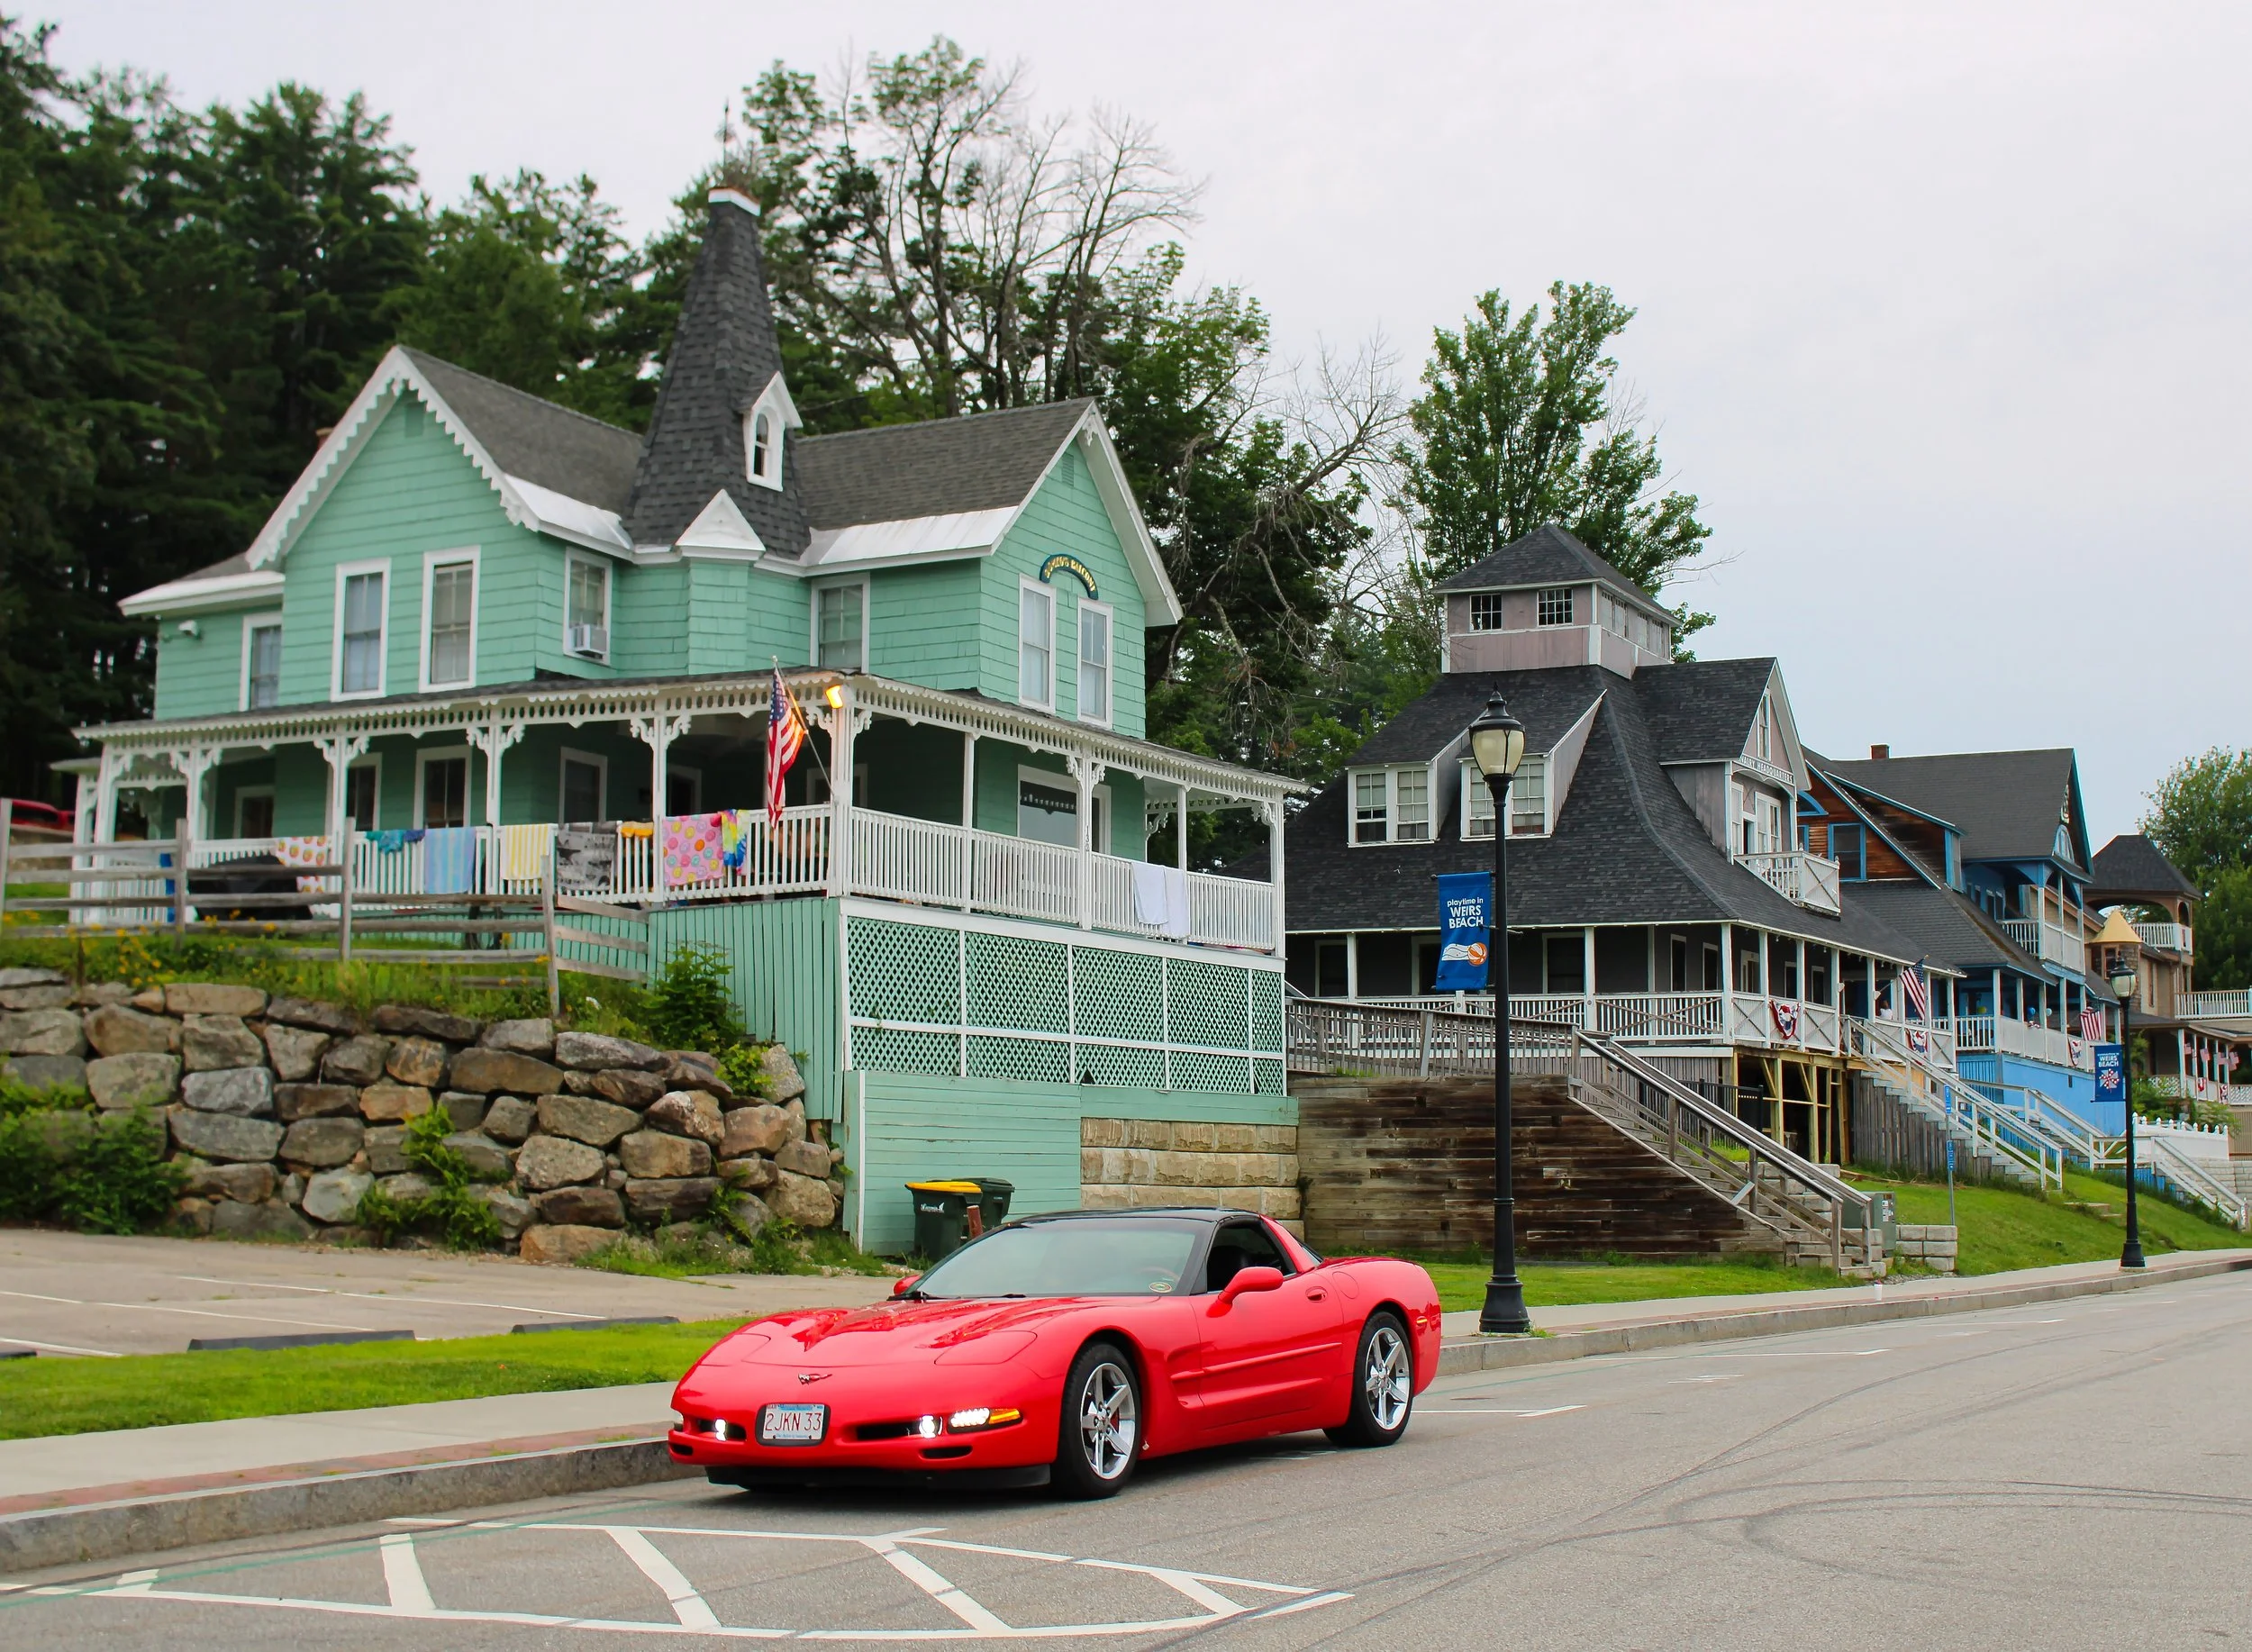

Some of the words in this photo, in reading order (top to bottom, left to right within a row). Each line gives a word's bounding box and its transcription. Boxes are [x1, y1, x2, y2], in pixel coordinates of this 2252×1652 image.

[1757, 761, 1793, 785] HEADQUARTERS
[1447, 898, 1476, 907] playtime
[1450, 904, 1482, 918] WEIRS
[1448, 916, 1484, 930] BEACH
[765, 1412, 801, 1431] 2JKN
[804, 1412, 822, 1431] 33
